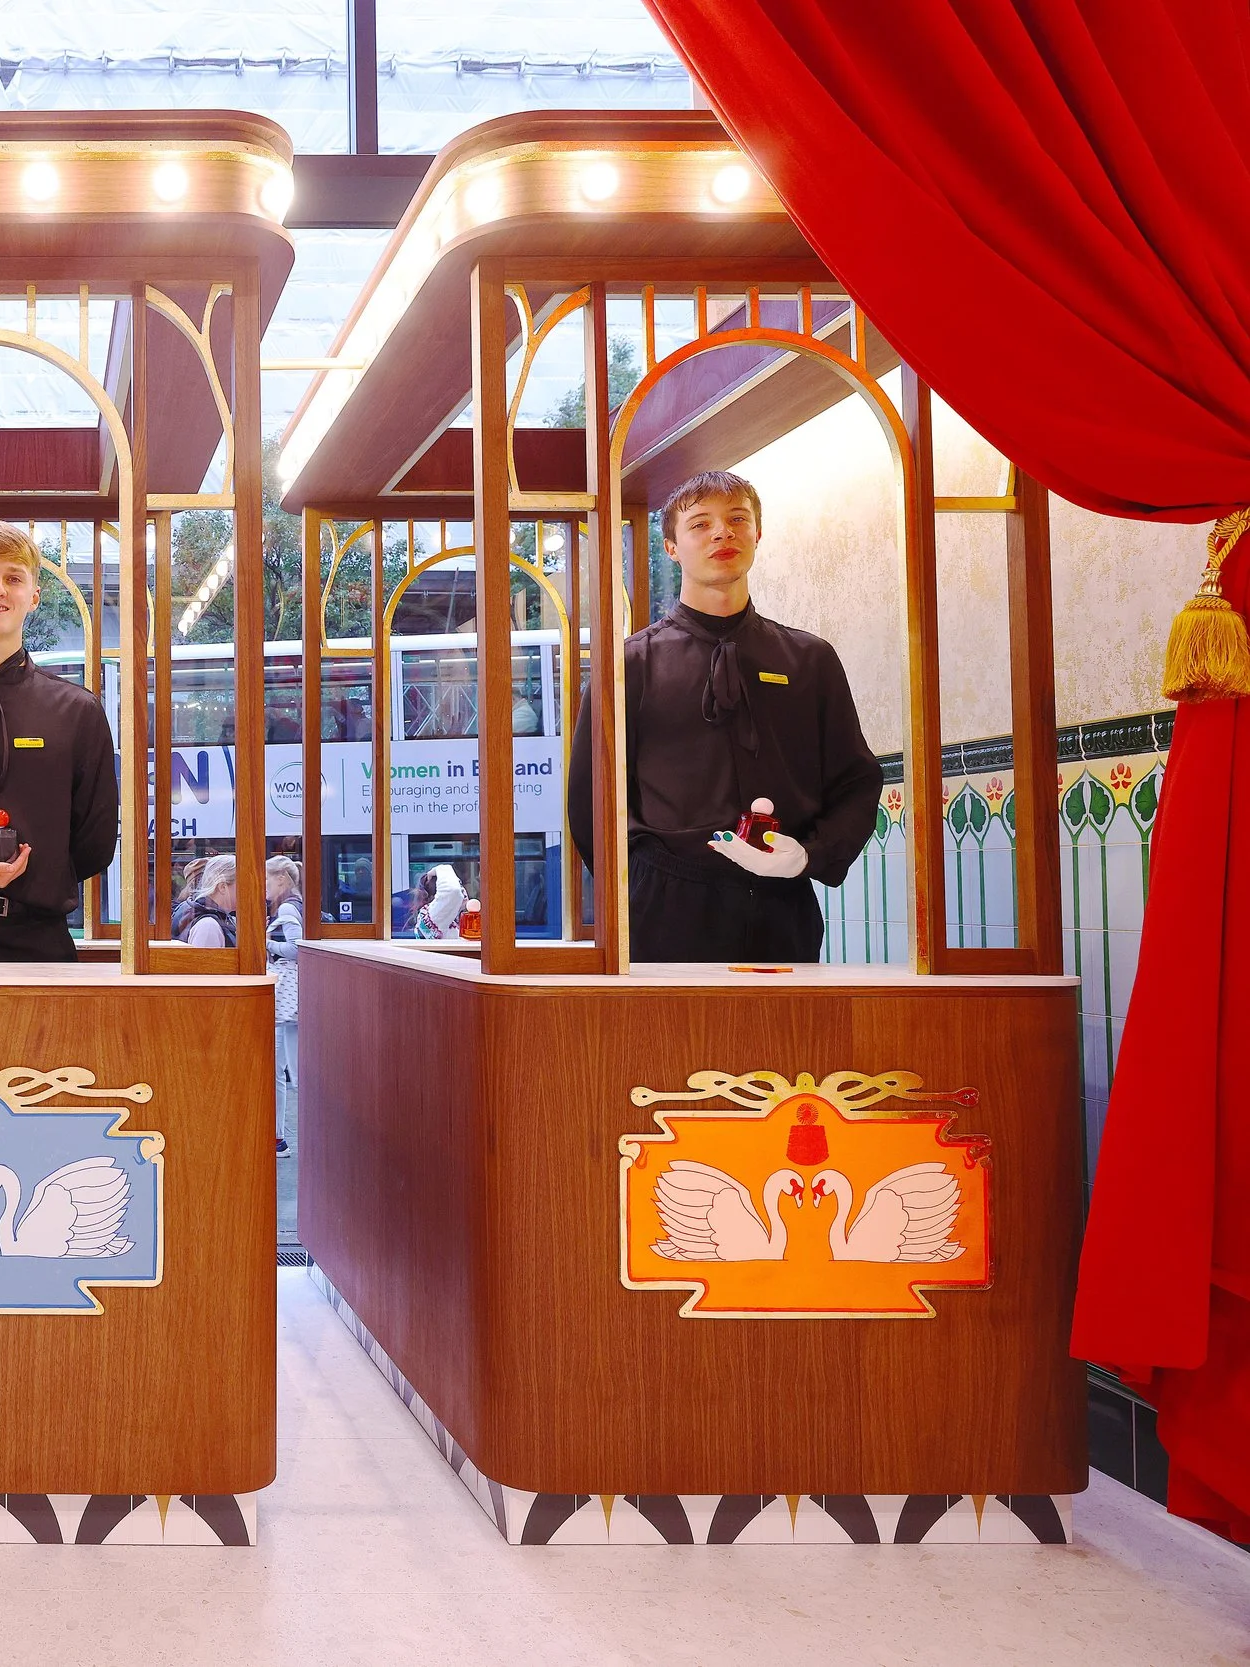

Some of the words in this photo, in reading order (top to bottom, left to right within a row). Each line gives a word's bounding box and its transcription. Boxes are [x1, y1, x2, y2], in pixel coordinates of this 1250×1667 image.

[447, 760, 464, 777] in
[472, 758, 552, 777] Eand
[362, 784, 440, 798] Euraging
[445, 783, 469, 795] and
[474, 783, 542, 796] srting
[362, 803, 408, 814] wen
[413, 802, 424, 813] in
[428, 801, 448, 813] the
[453, 800, 519, 815] profn
